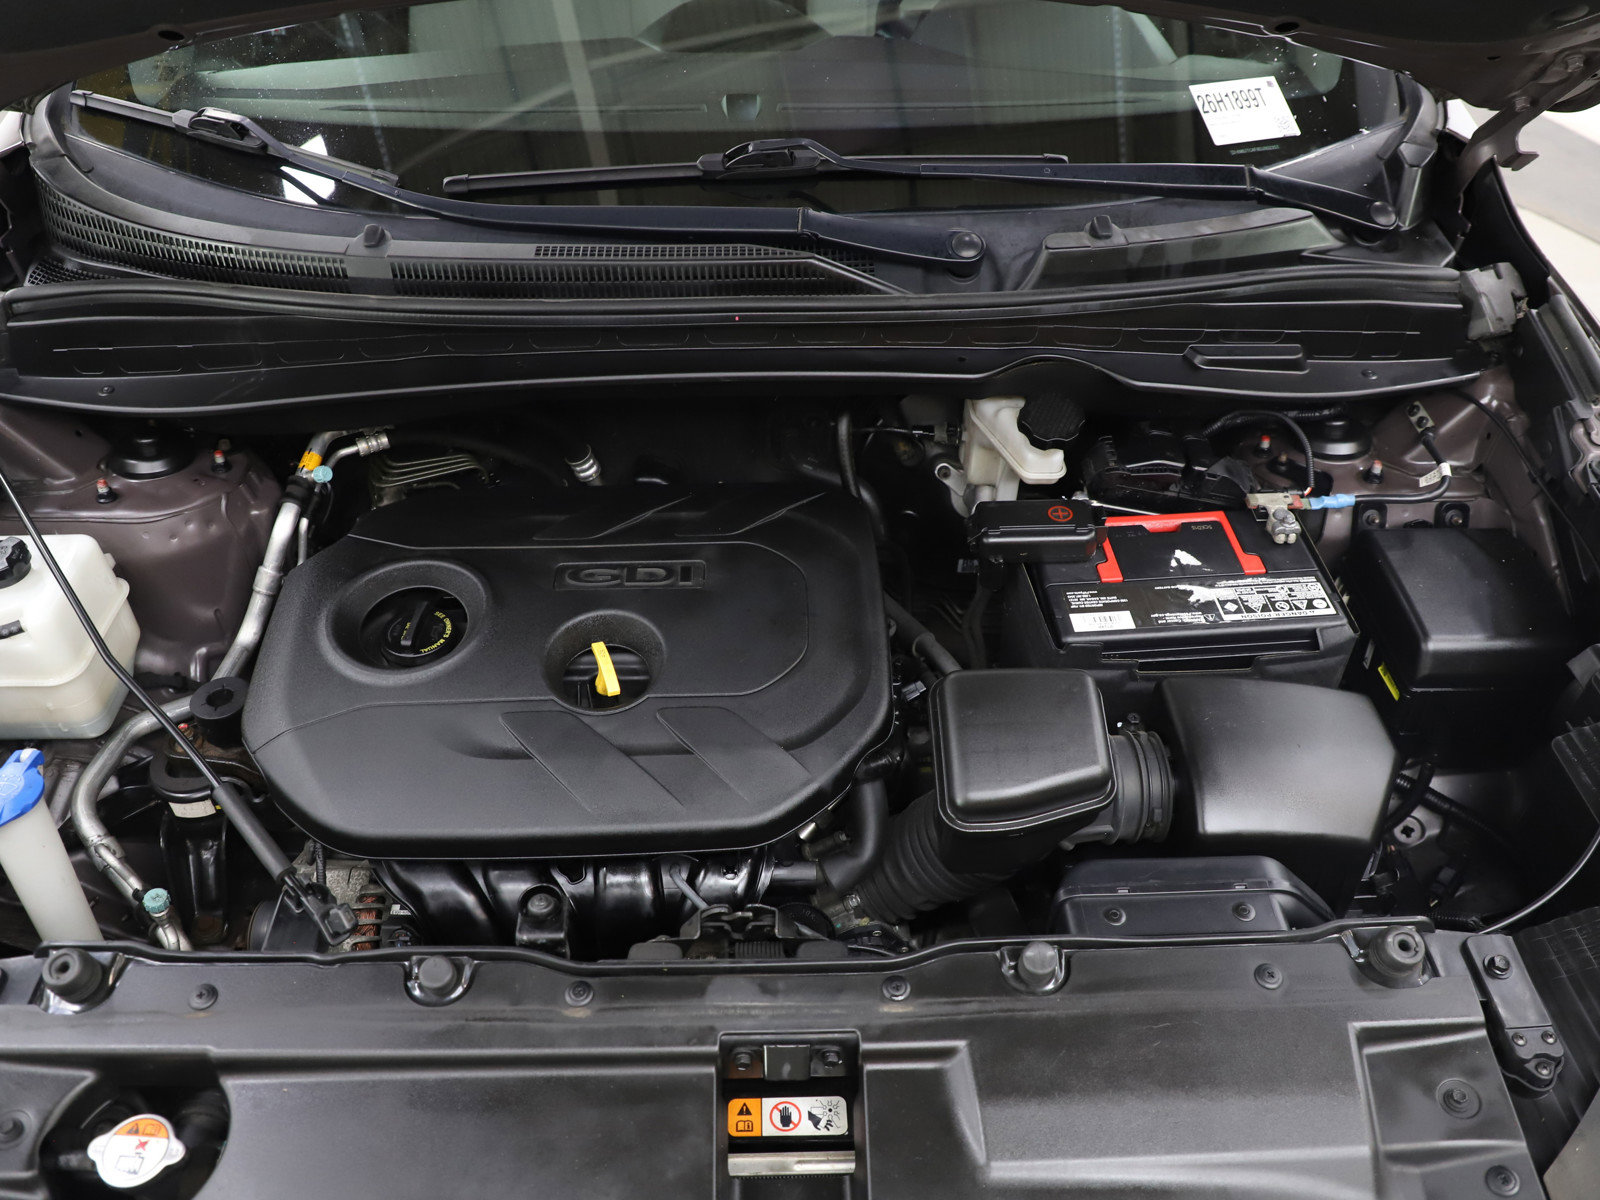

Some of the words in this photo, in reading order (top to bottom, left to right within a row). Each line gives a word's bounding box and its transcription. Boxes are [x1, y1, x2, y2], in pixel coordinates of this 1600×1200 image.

[1197, 88, 1267, 114] 26H1899T
[566, 566, 694, 587] GDI
[420, 638, 446, 654] MANUAL
